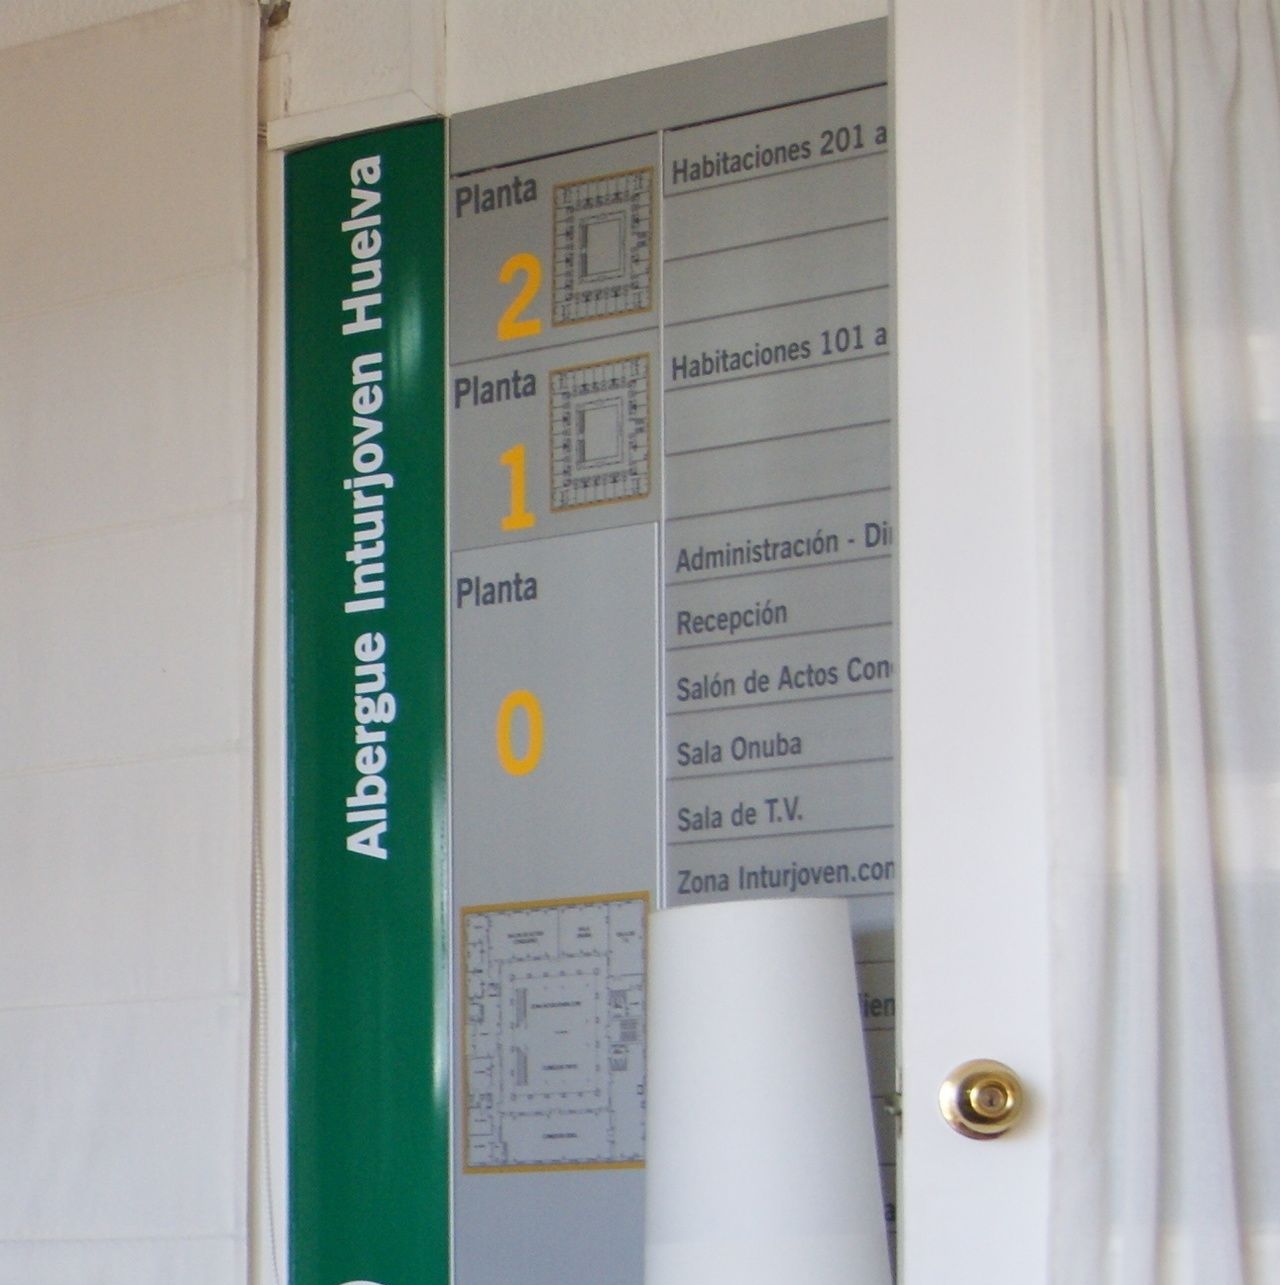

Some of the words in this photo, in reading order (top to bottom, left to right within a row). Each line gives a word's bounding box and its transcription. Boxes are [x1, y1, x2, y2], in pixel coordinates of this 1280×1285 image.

[672, 138, 812, 186] Habitaciones
[820, 123, 864, 156] 201
[874, 125, 887, 145] a
[454, 176, 538, 219] Planta
[341, 154, 384, 336] Huelva
[496, 252, 543, 342] 2
[671, 335, 811, 381] Habitaciones
[820, 323, 864, 356] 101
[874, 327, 888, 348] a
[453, 370, 538, 409] Planta
[342, 351, 395, 614] Inturjoven
[499, 443, 536, 533] 1
[675, 526, 839, 574] Administración
[455, 572, 539, 609] Planta
[675, 601, 789, 637] Recepción
[676, 665, 736, 702] Salón
[743, 664, 770, 695] de
[777, 660, 840, 691] Actos
[846, 656, 894, 682] Con
[345, 632, 397, 861] Albergue
[495, 689, 545, 777] 0
[676, 739, 723, 768] Sala
[730, 731, 803, 762] Onuba
[677, 804, 723, 833] Sala
[732, 799, 757, 828] de
[764, 796, 805, 825] T.V.
[677, 867, 730, 895] Zona
